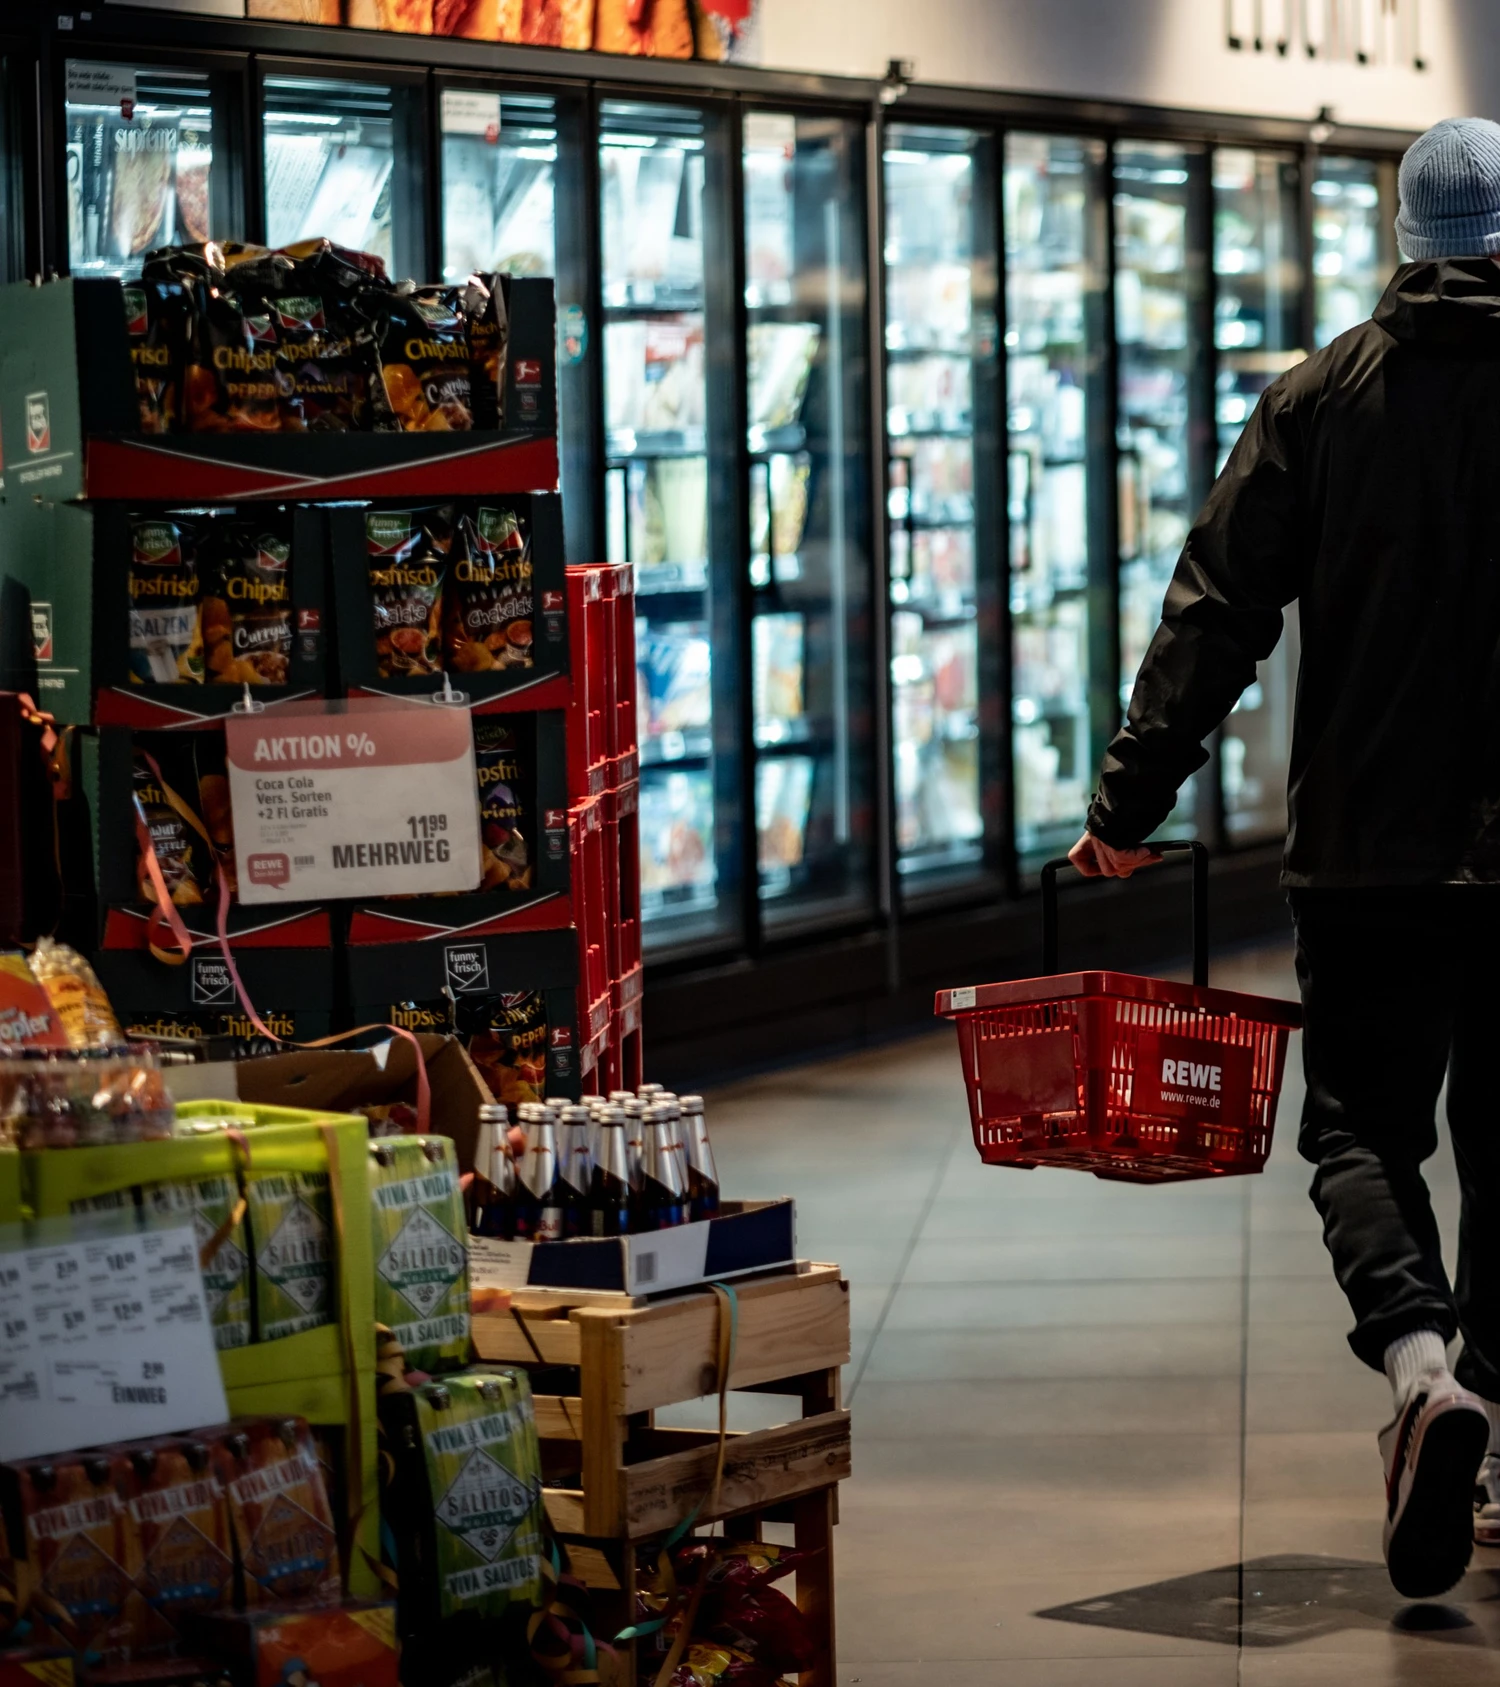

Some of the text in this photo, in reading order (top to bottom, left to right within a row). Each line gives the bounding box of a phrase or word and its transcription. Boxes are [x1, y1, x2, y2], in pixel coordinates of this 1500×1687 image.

[254, 732, 376, 762] AKTION %
[256, 776, 314, 791] Coca Cola
[257, 791, 332, 805] Vers. Sorten
[258, 807, 273, 820] +2
[292, 805, 329, 819] Gratis
[333, 839, 450, 869] MEHRWEG
[254, 859, 283, 870] REWE
[450, 950, 479, 963] funny-
[198, 963, 228, 976] funny-
[454, 961, 482, 974] frisch
[202, 974, 230, 986] frisch
[1161, 1058, 1222, 1091] REWE
[1161, 1090, 1221, 1108] www.rewe.de
[389, 1244, 460, 1271] SALITOS
[418, 1315, 466, 1343] SALITOS
[450, 1486, 523, 1517] SALITOS
[484, 1557, 535, 1588] SALITOS
